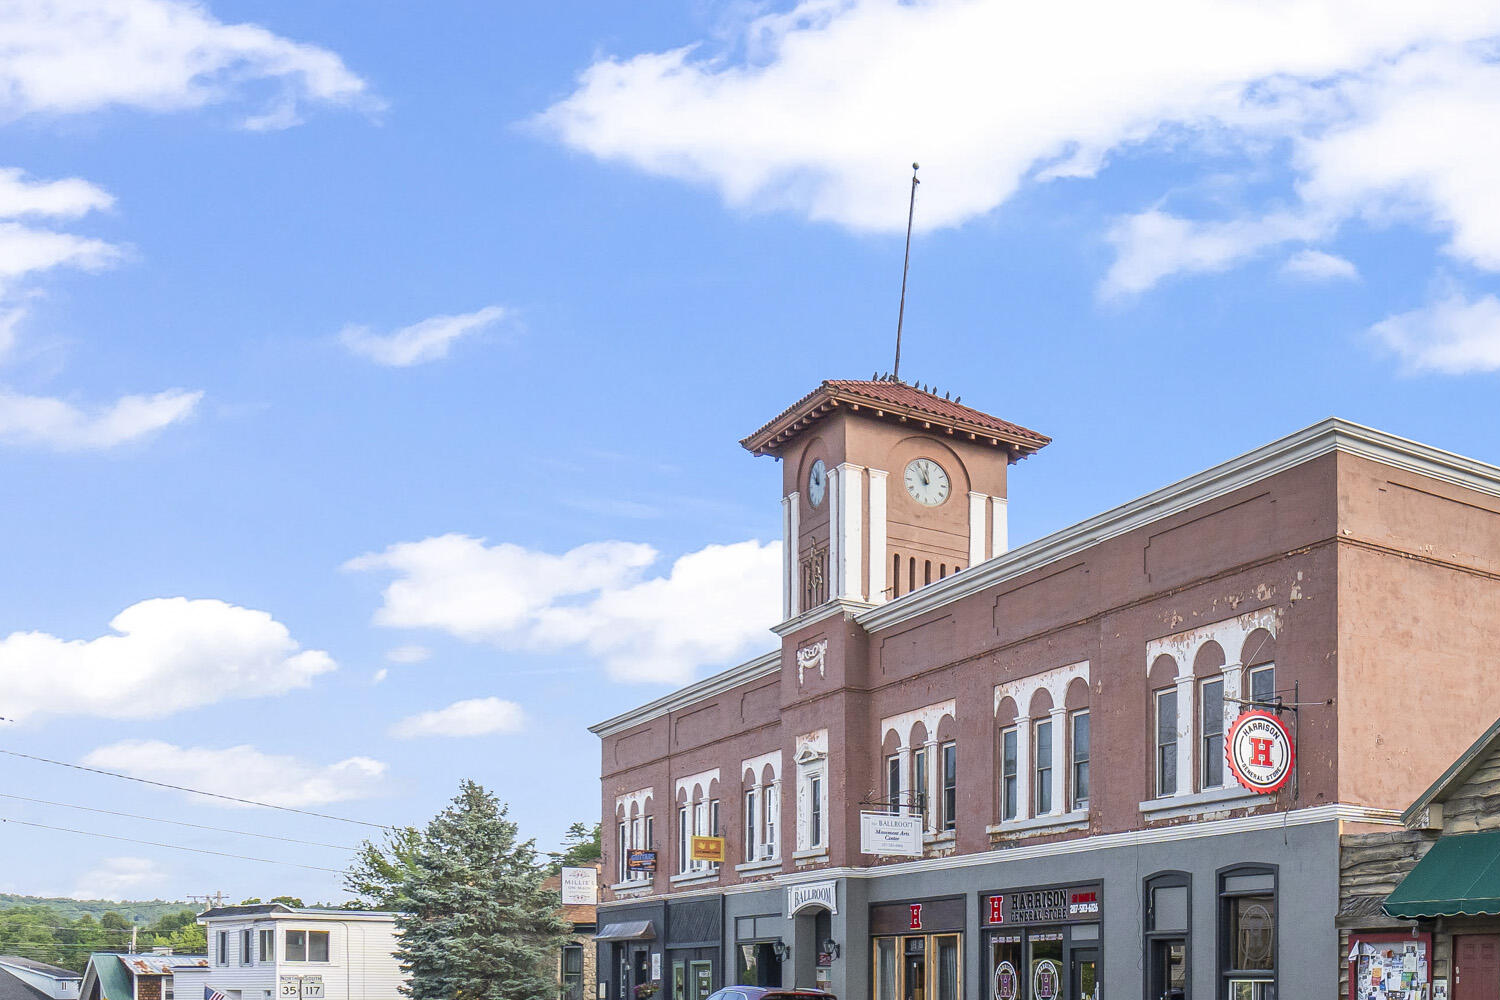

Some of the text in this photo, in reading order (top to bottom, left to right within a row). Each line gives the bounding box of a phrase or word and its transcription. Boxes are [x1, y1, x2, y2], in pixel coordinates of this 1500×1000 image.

[1242, 723, 1280, 739] HARRISON
[1249, 736, 1274, 768] H
[1242, 764, 1282, 781] GENERAL STORE
[878, 820, 913, 828] BALLROOM
[794, 887, 832, 907] BALLROOM
[1011, 889, 1067, 910] HARRISON
[909, 904, 922, 930] H
[989, 896, 1003, 923] H
[1011, 908, 1067, 922] GENERAL STORE
[282, 986, 297, 995] 35
[305, 986, 320, 995] 117
